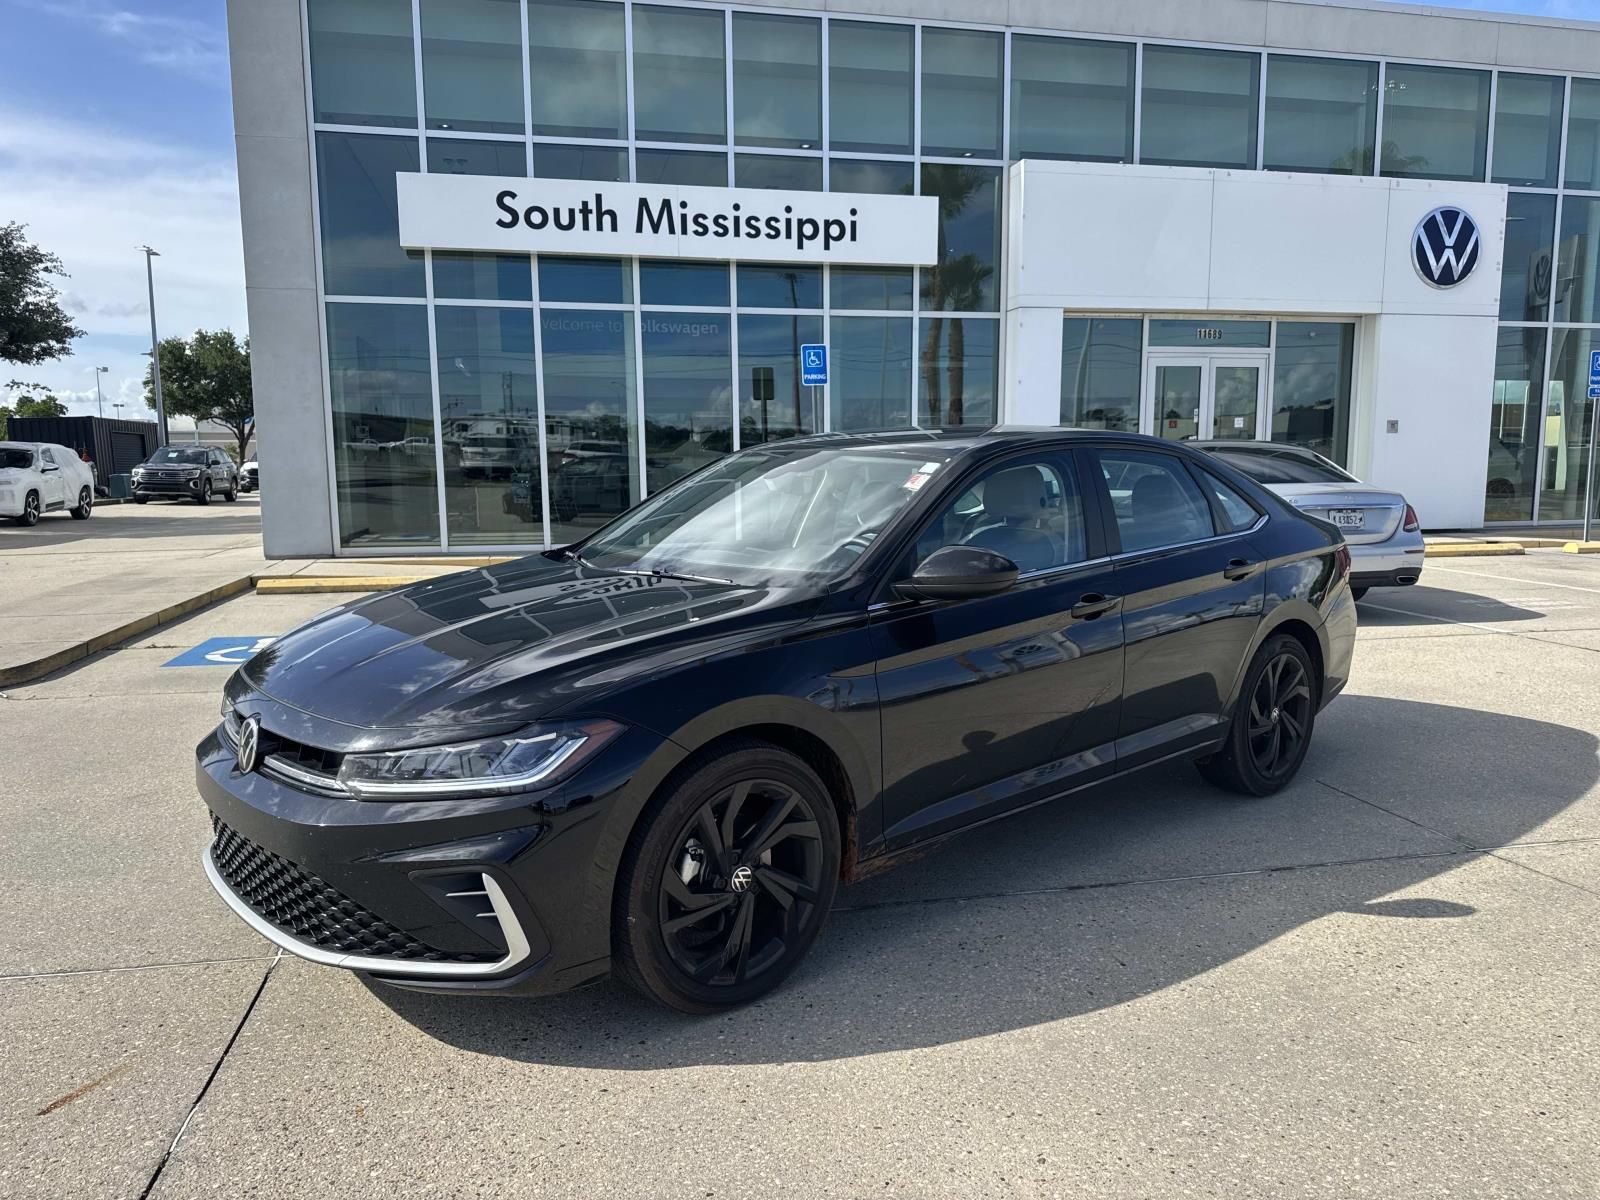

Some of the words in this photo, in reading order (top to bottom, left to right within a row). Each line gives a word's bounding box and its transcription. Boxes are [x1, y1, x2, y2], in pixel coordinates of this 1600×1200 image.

[495, 190, 618, 233] South
[635, 197, 858, 251] Mississippi
[1415, 209, 1480, 284] VW
[608, 319, 623, 333] to
[641, 319, 719, 337] olkswagen
